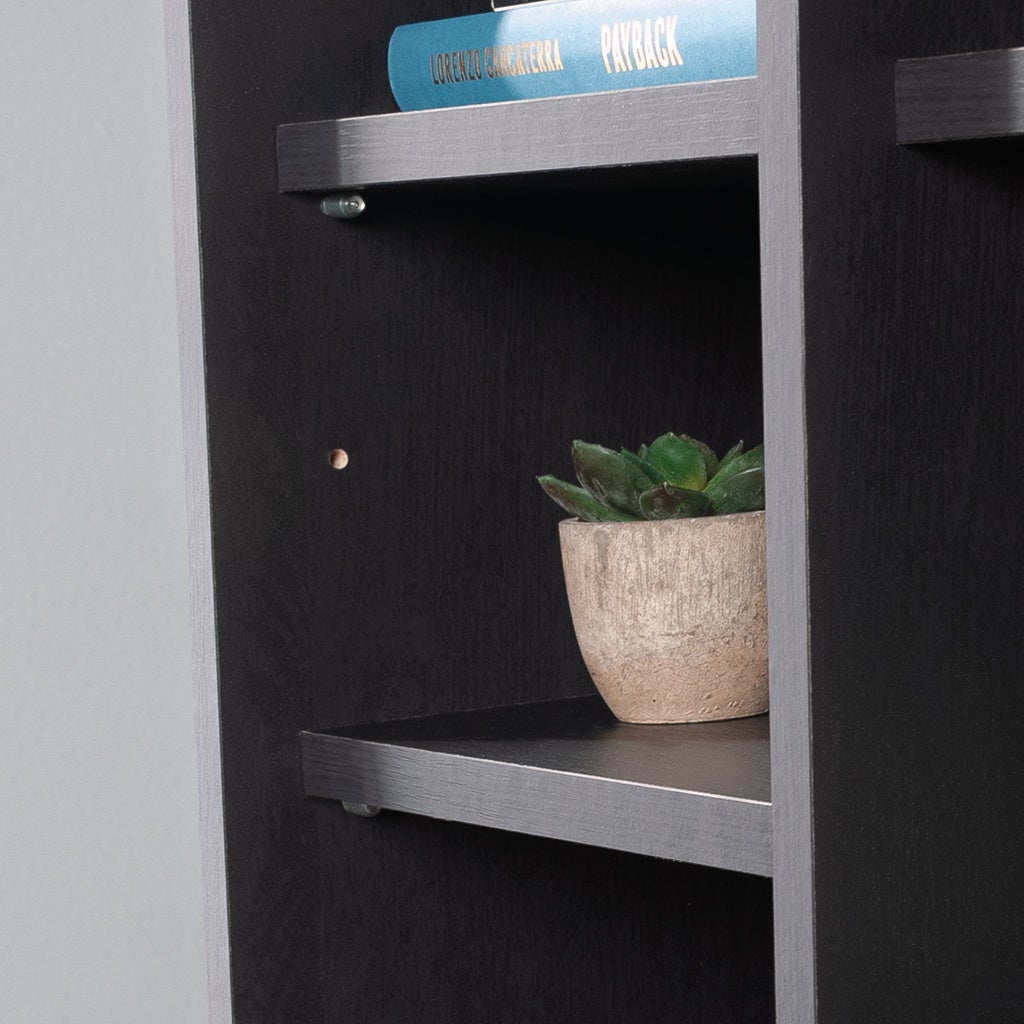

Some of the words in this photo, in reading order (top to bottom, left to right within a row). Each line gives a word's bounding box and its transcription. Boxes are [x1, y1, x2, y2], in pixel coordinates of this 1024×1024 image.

[430, 49, 482, 85] LORENZO
[484, 38, 564, 79] CARCATERRA
[600, 15, 684, 74] PAYBACK
